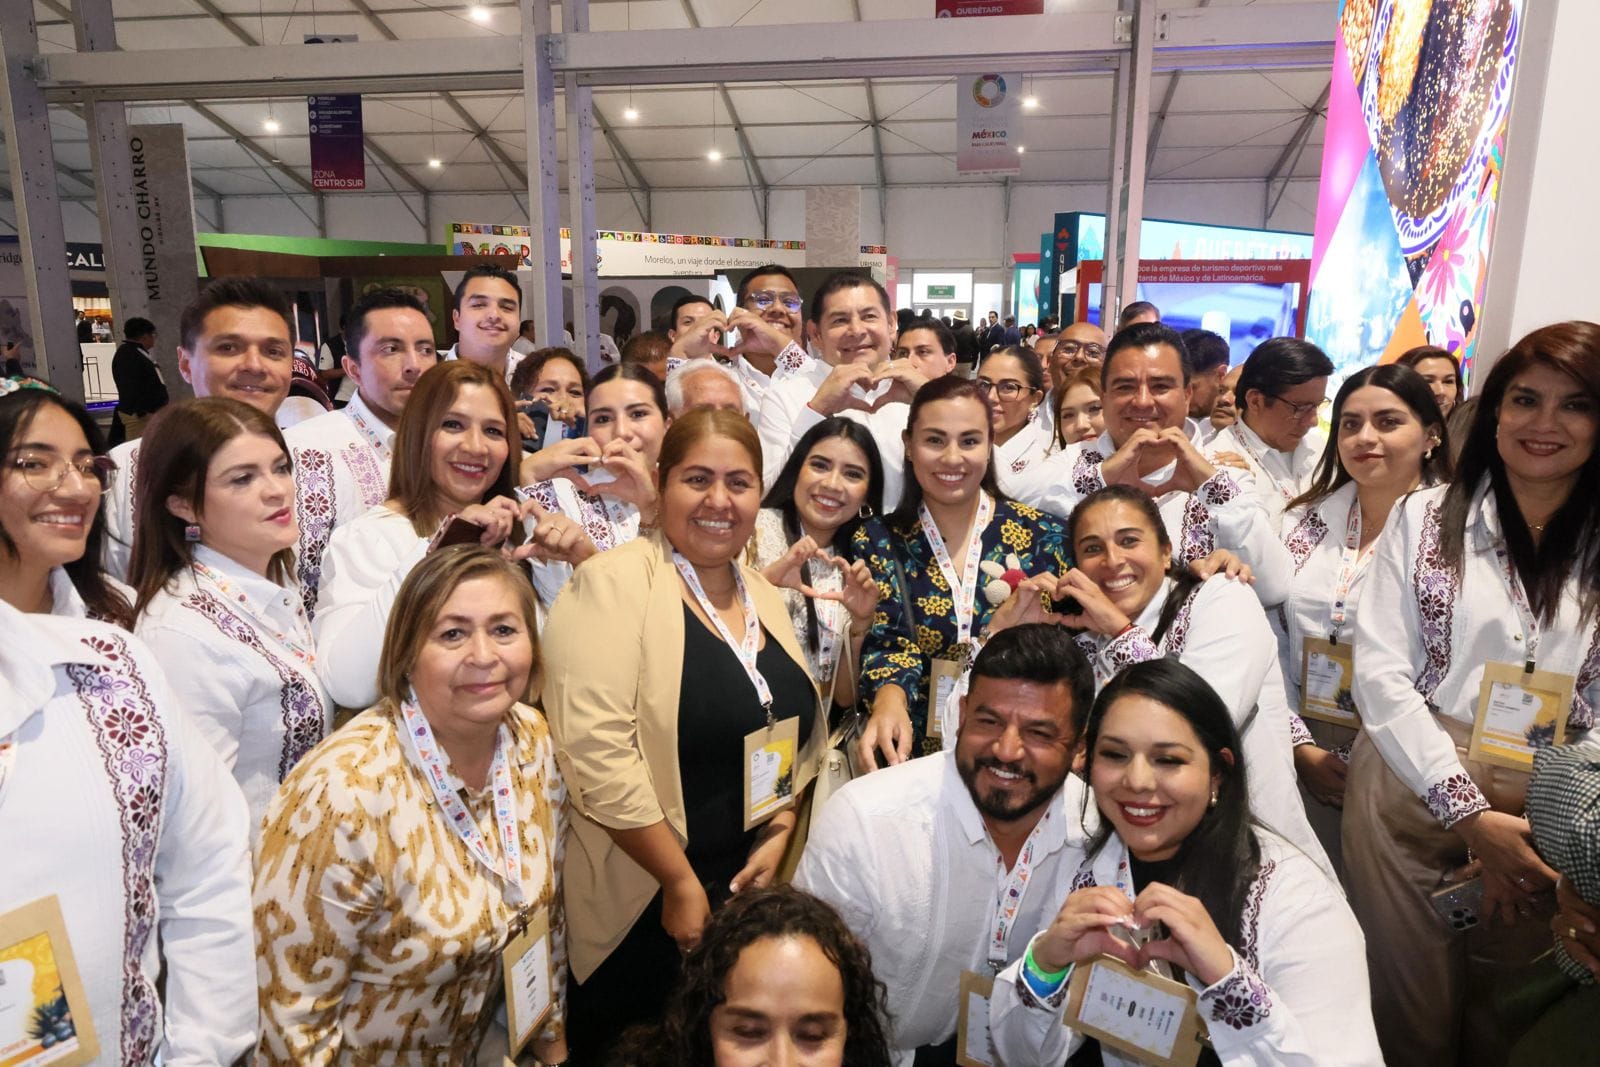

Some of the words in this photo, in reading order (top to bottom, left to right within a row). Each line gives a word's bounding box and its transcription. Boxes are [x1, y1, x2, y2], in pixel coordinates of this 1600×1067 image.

[956, 6, 1003, 15] QUERÉTARO
[130, 137, 150, 219] CHARRO
[314, 179, 345, 187] CENTRO
[347, 179, 364, 187] SUR
[141, 227, 160, 300] MUNDO
[688, 258, 702, 267] viaje
[704, 257, 725, 265] donde
[1192, 264, 1200, 272] de
[1202, 264, 1229, 272] turismo
[1231, 264, 1266, 273] deportivo
[1159, 274, 1168, 282] de
[1169, 274, 1194, 282] México
